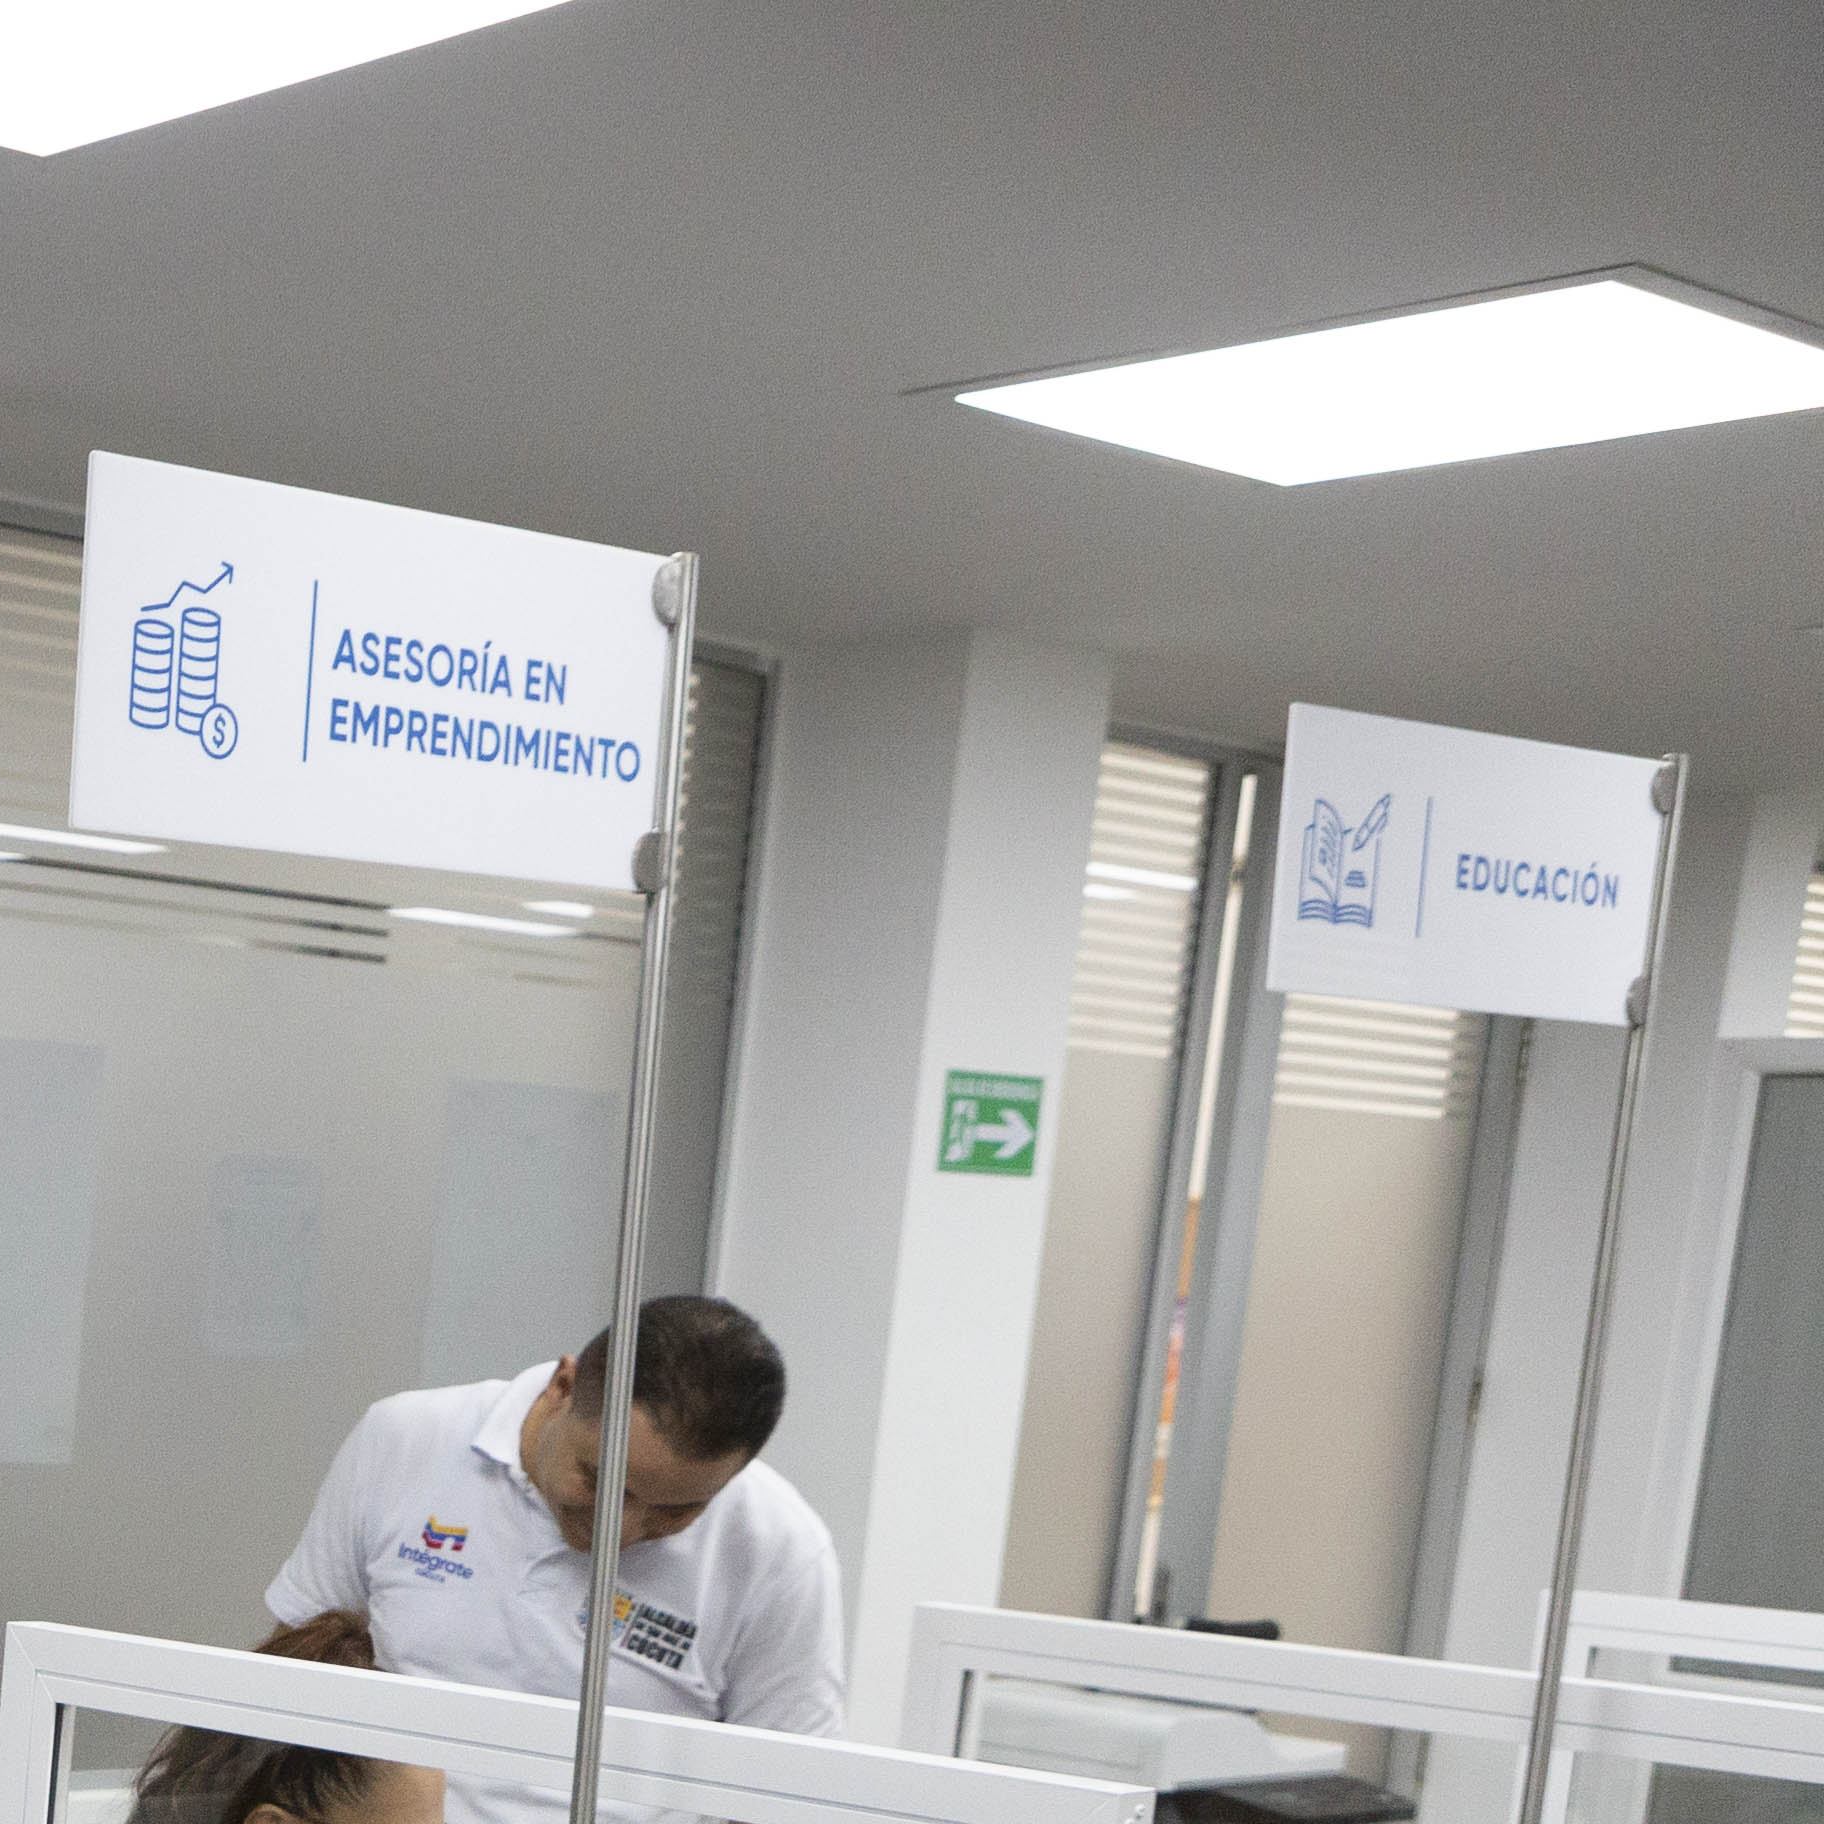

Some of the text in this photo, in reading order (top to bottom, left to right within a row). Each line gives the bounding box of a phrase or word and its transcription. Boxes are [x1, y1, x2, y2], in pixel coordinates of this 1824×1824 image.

[332, 628, 567, 705] ASESORÍA EN
[328, 697, 641, 783] EMPRENDIMIENTO
[1455, 852, 1620, 910] EDUCACIÓN
